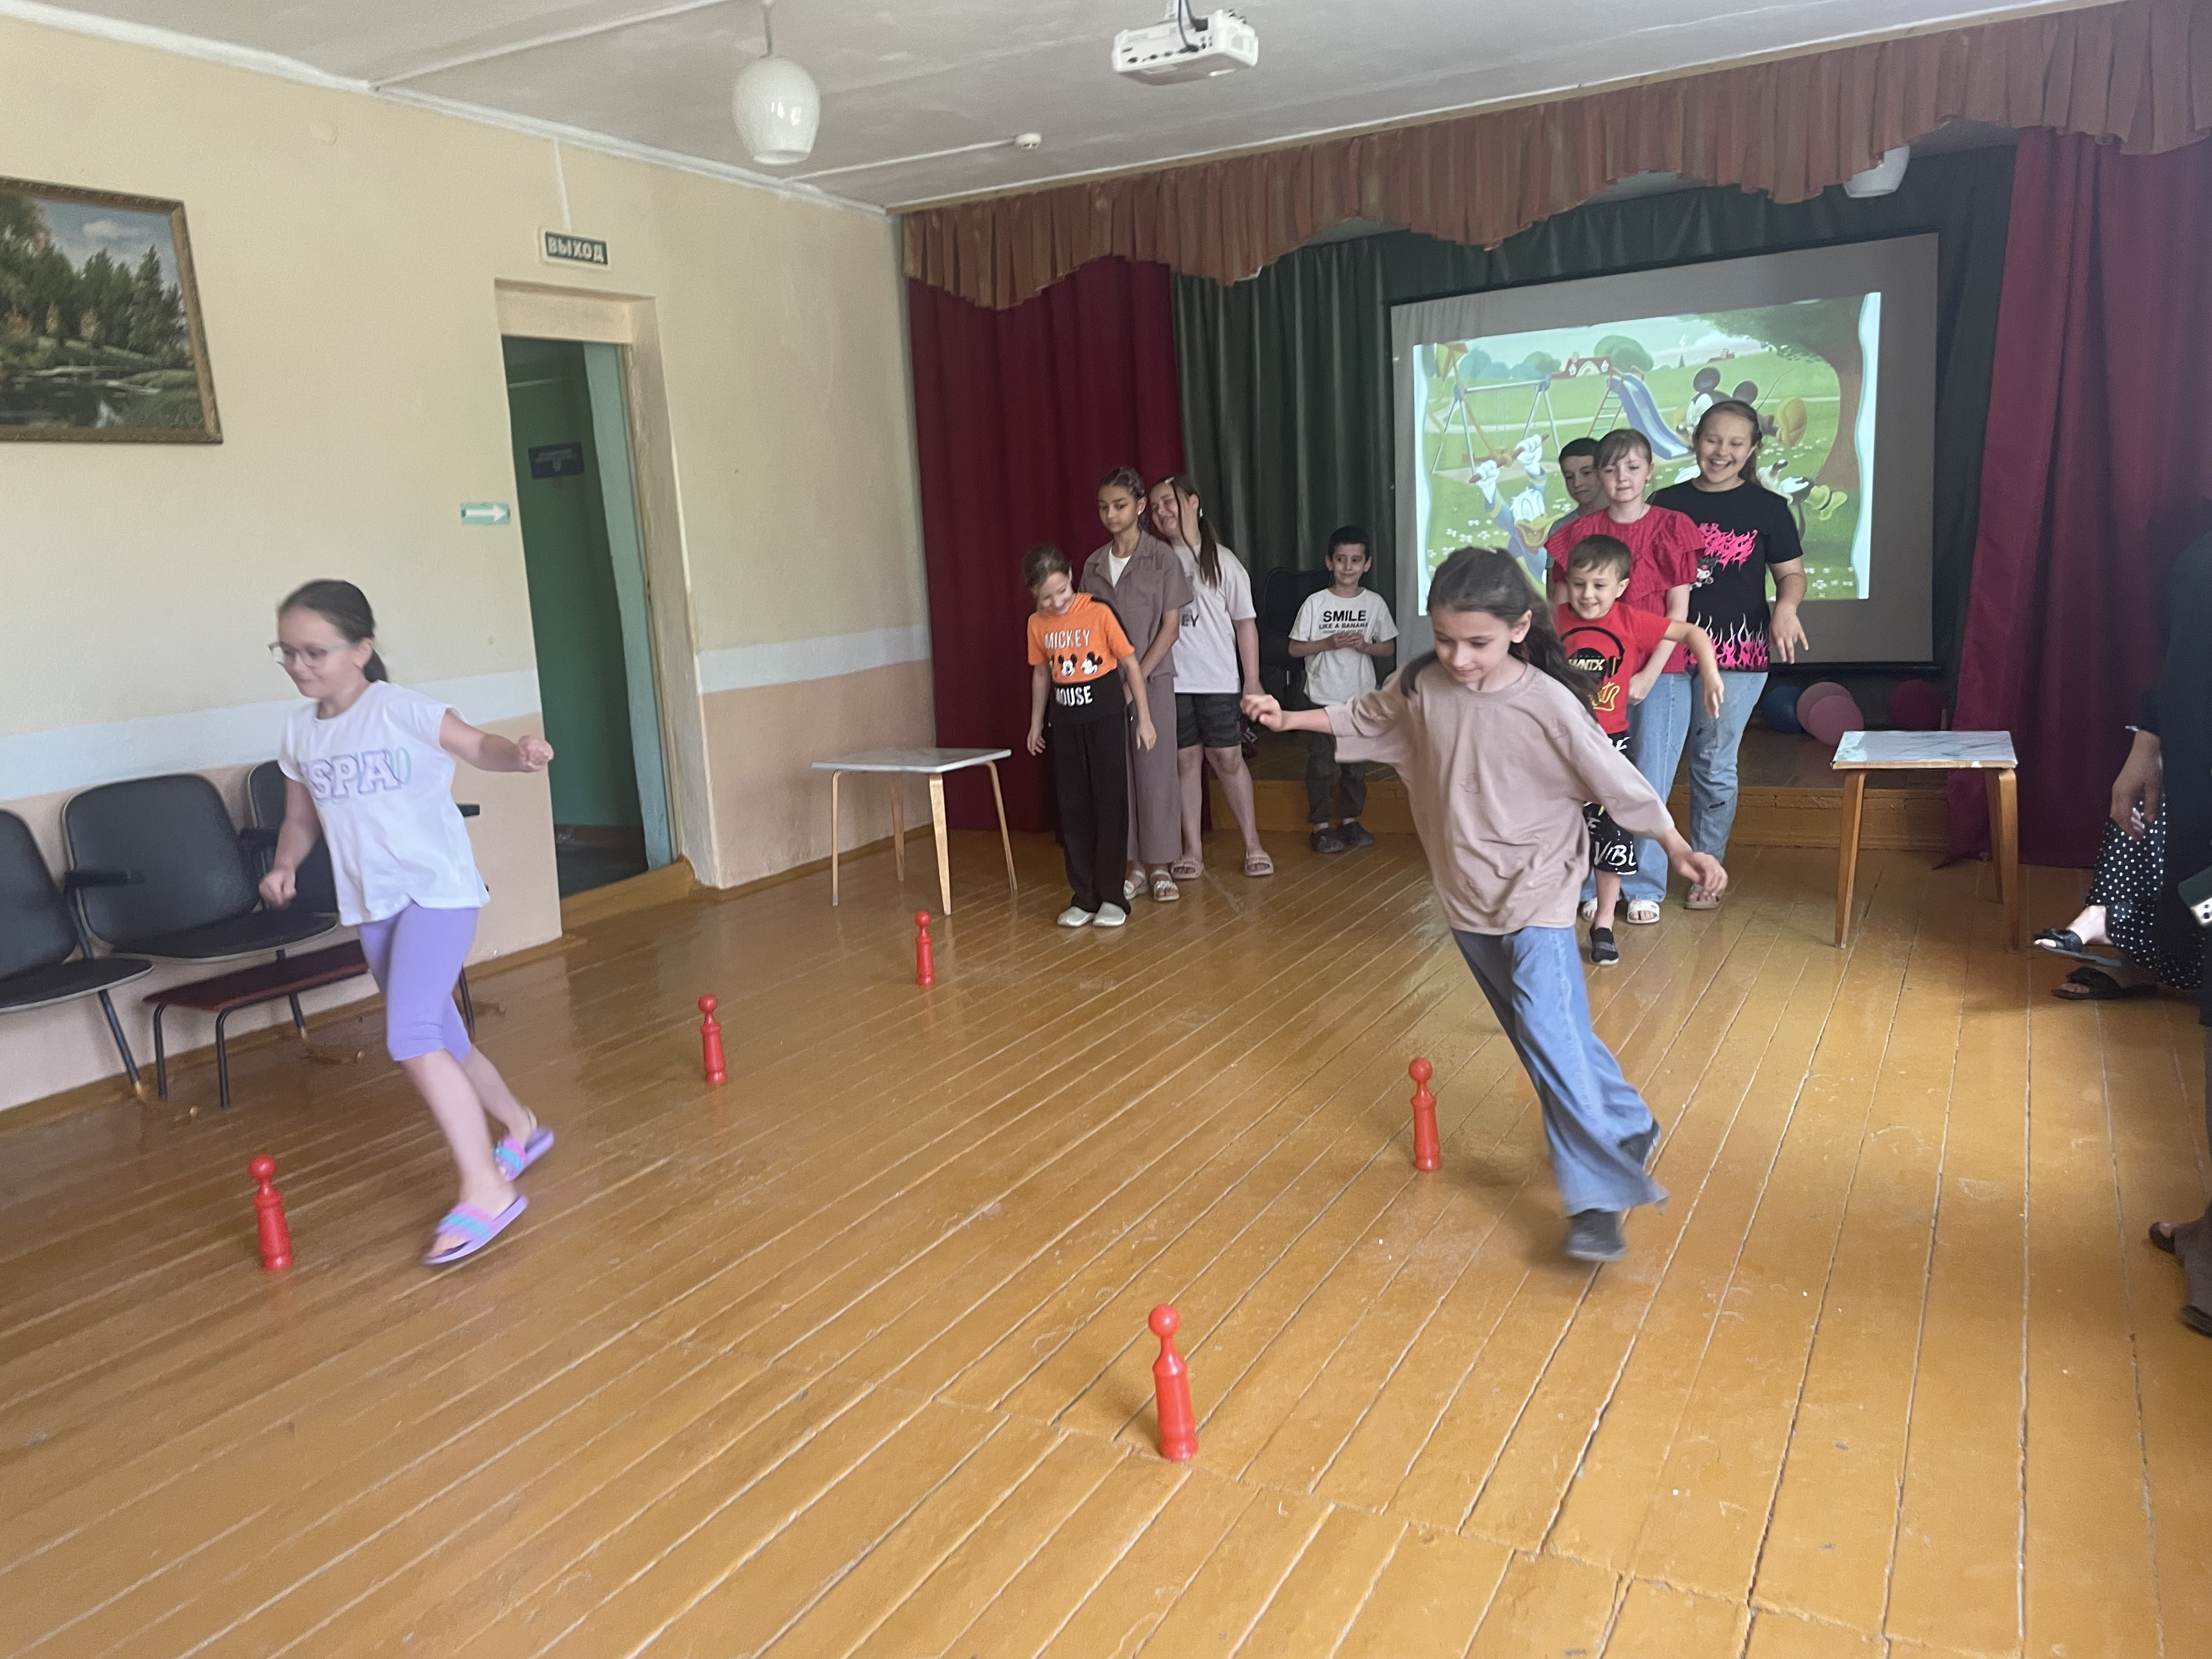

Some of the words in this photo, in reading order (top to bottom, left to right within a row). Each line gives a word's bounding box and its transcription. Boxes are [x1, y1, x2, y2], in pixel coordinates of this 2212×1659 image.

[548, 235, 605, 263] ВЫХОД
[1323, 610, 1367, 622] SMILE
[1044, 629, 1090, 650] MICKEY
